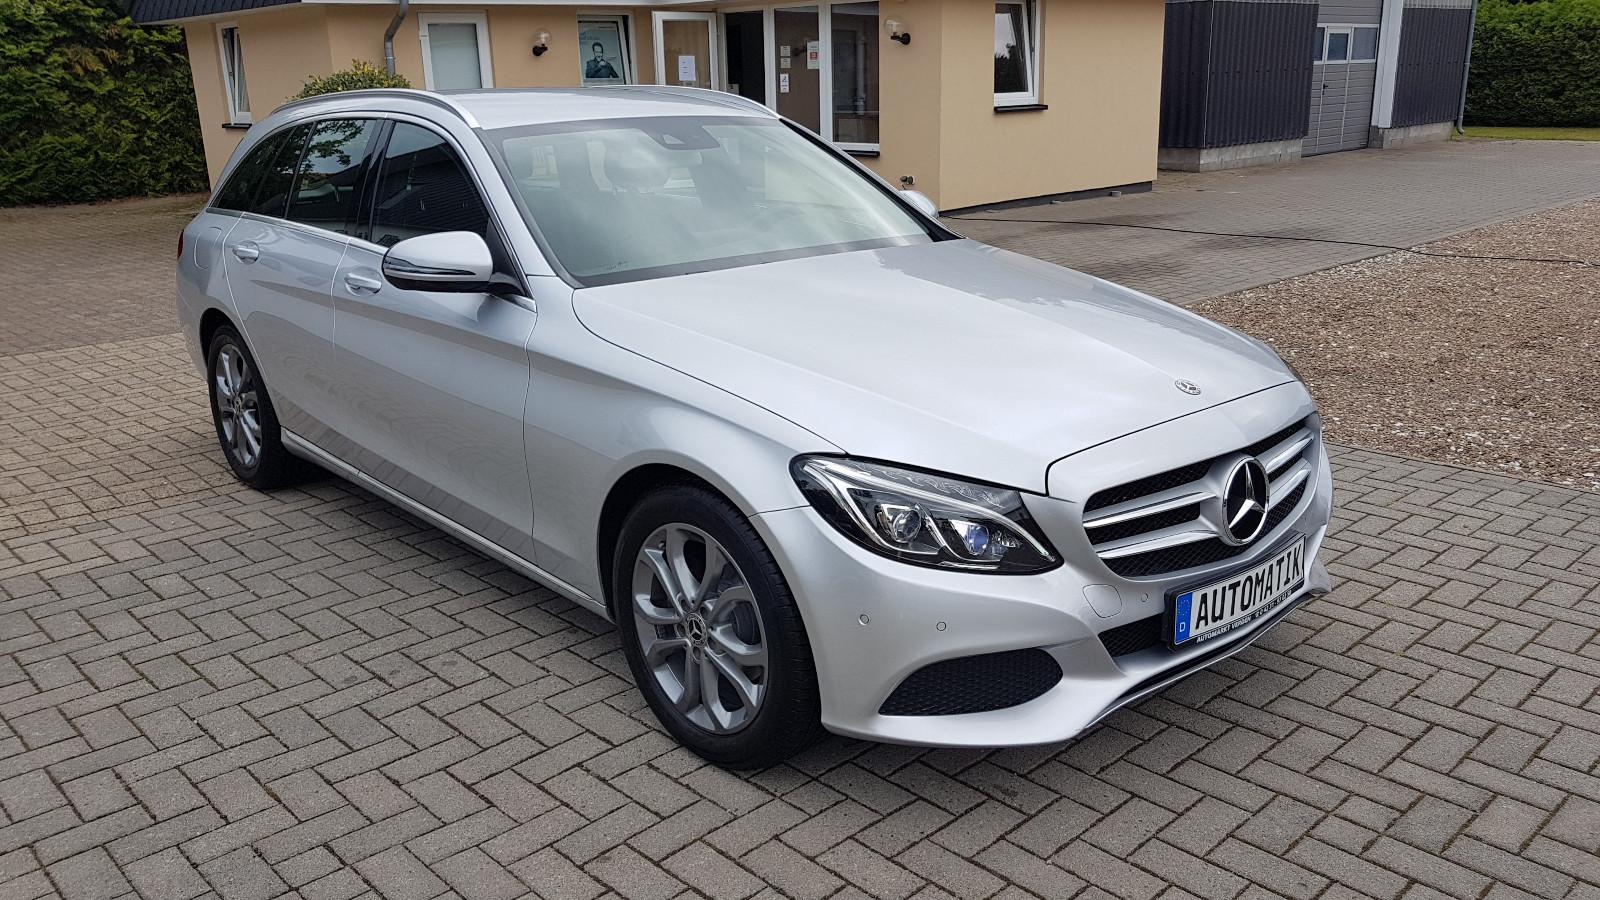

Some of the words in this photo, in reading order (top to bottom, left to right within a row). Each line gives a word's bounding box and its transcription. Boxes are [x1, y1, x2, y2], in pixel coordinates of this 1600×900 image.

[1195, 544, 1302, 630] AUTOMATIK
[1179, 622, 1186, 633] D
[1196, 624, 1231, 643] AUTOMARKT
